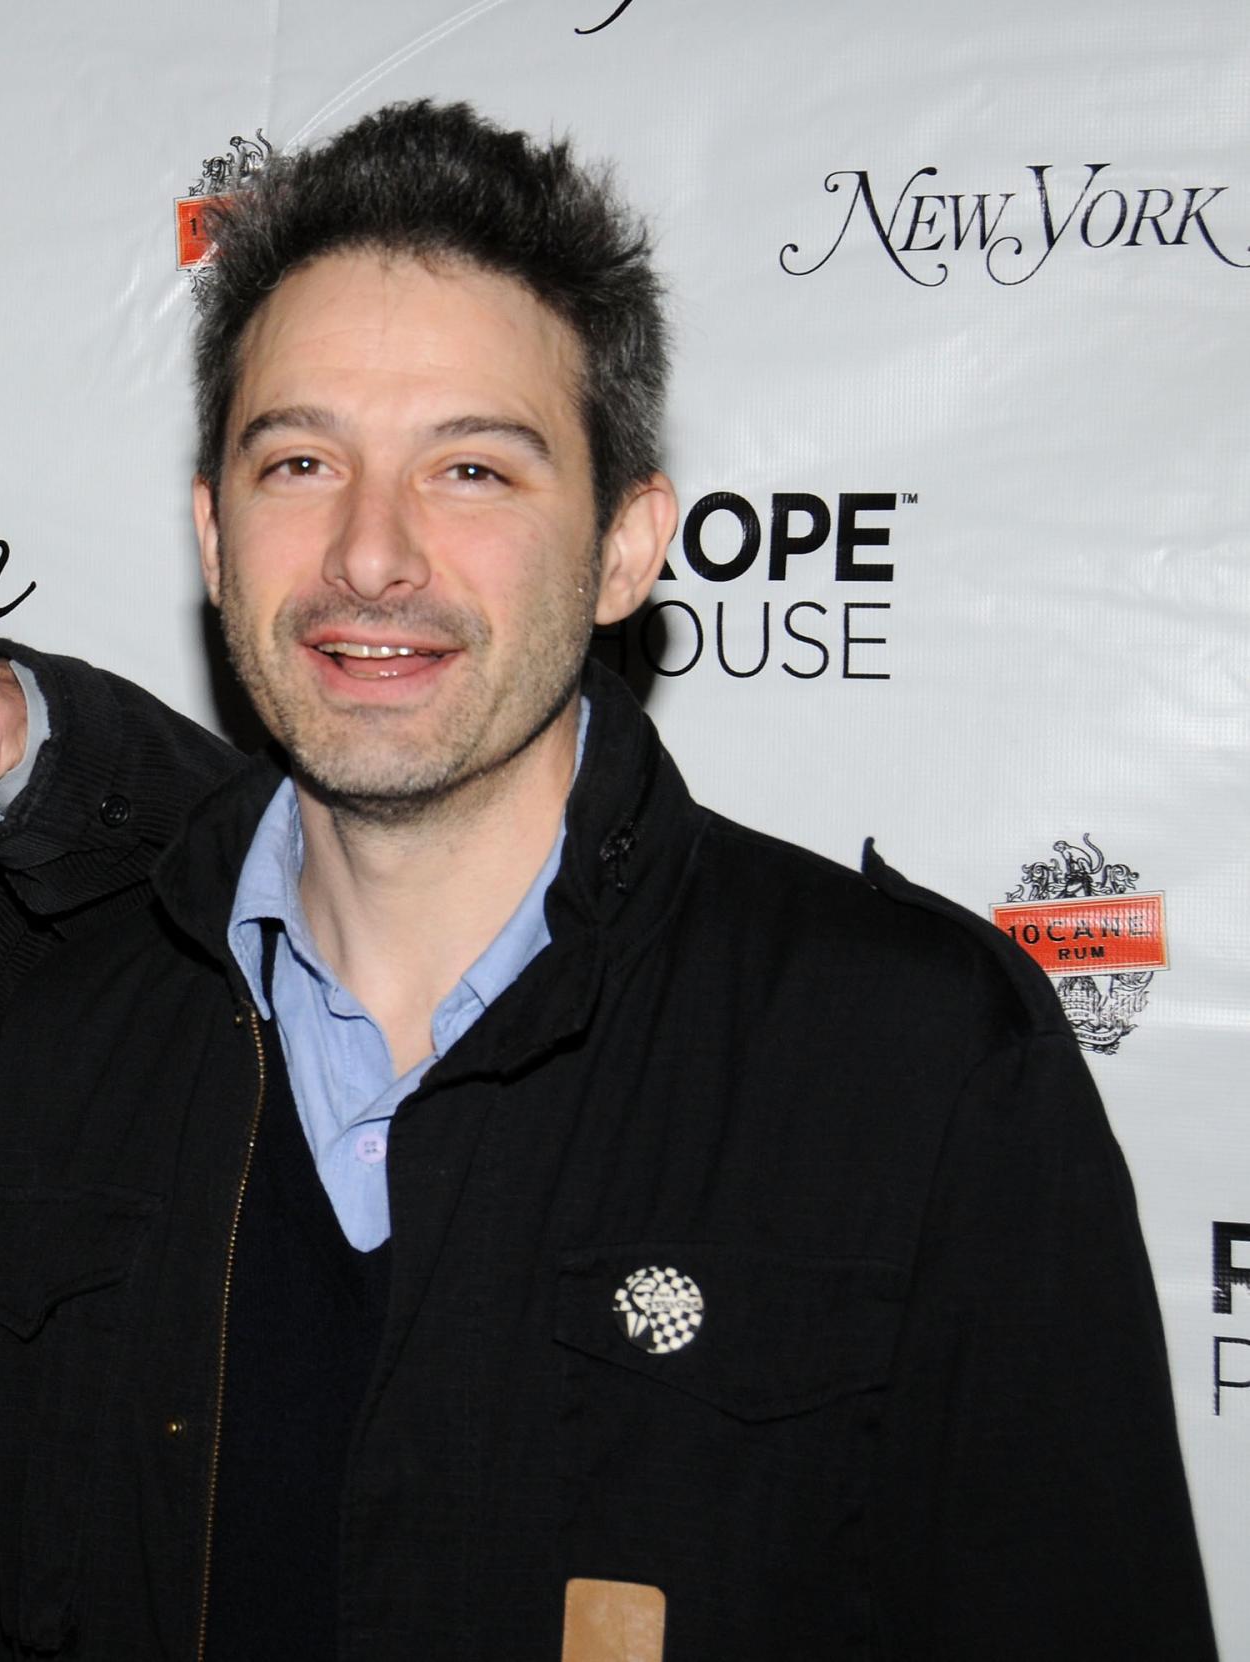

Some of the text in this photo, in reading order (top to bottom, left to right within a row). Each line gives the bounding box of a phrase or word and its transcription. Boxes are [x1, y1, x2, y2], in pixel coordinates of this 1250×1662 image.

[780, 163, 1250, 287] NEW YORK
[658, 491, 897, 582] OPE
[639, 600, 891, 680] OUSE
[1058, 946, 1105, 960] RUM
